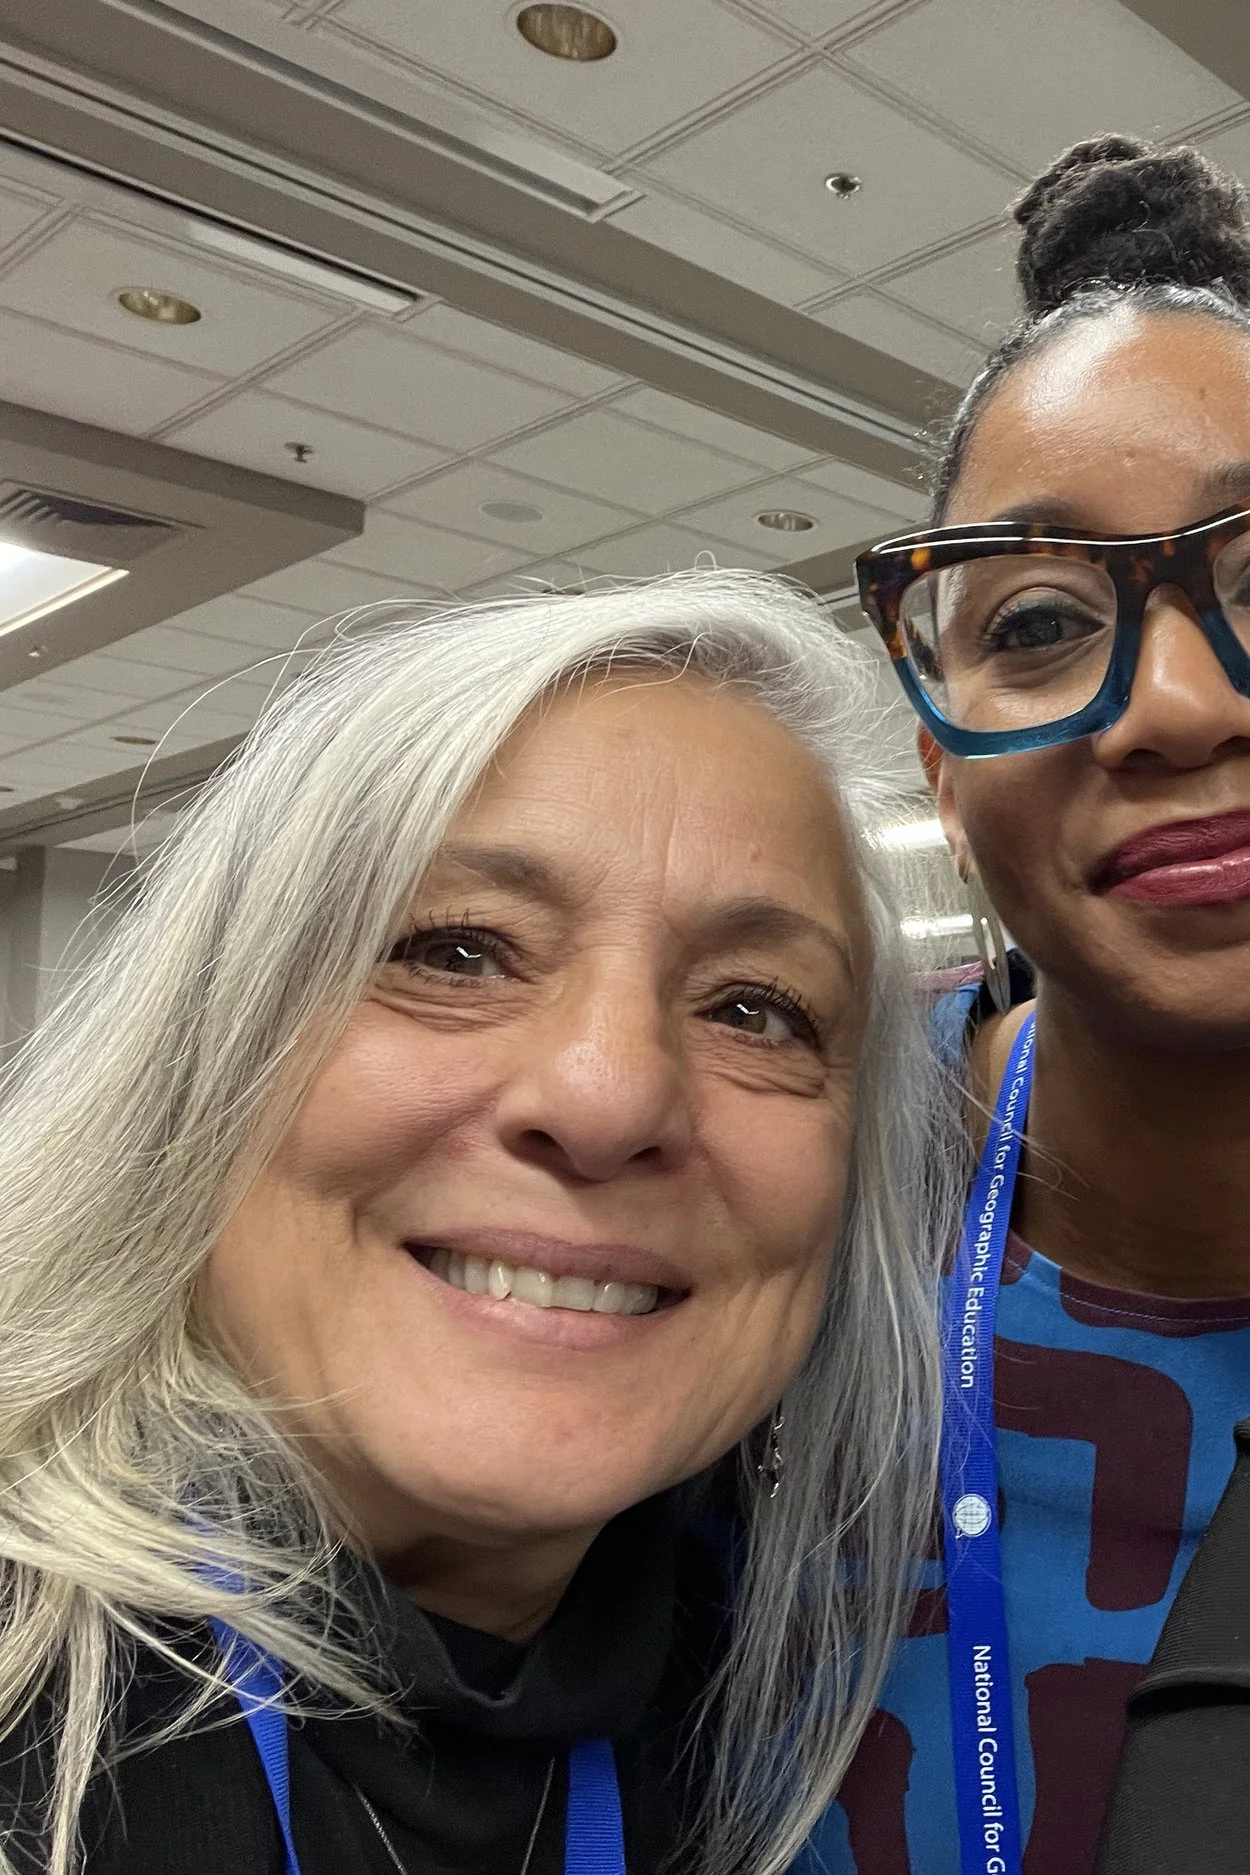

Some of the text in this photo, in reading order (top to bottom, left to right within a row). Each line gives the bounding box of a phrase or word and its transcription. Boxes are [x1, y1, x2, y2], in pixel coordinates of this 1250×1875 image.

[994, 1144, 1011, 1170] for
[999, 1077, 1024, 1142] Council
[970, 1174, 1005, 1283] Geographic
[960, 1287, 985, 1388] Education
[972, 1645, 1006, 1875] National Council for G
